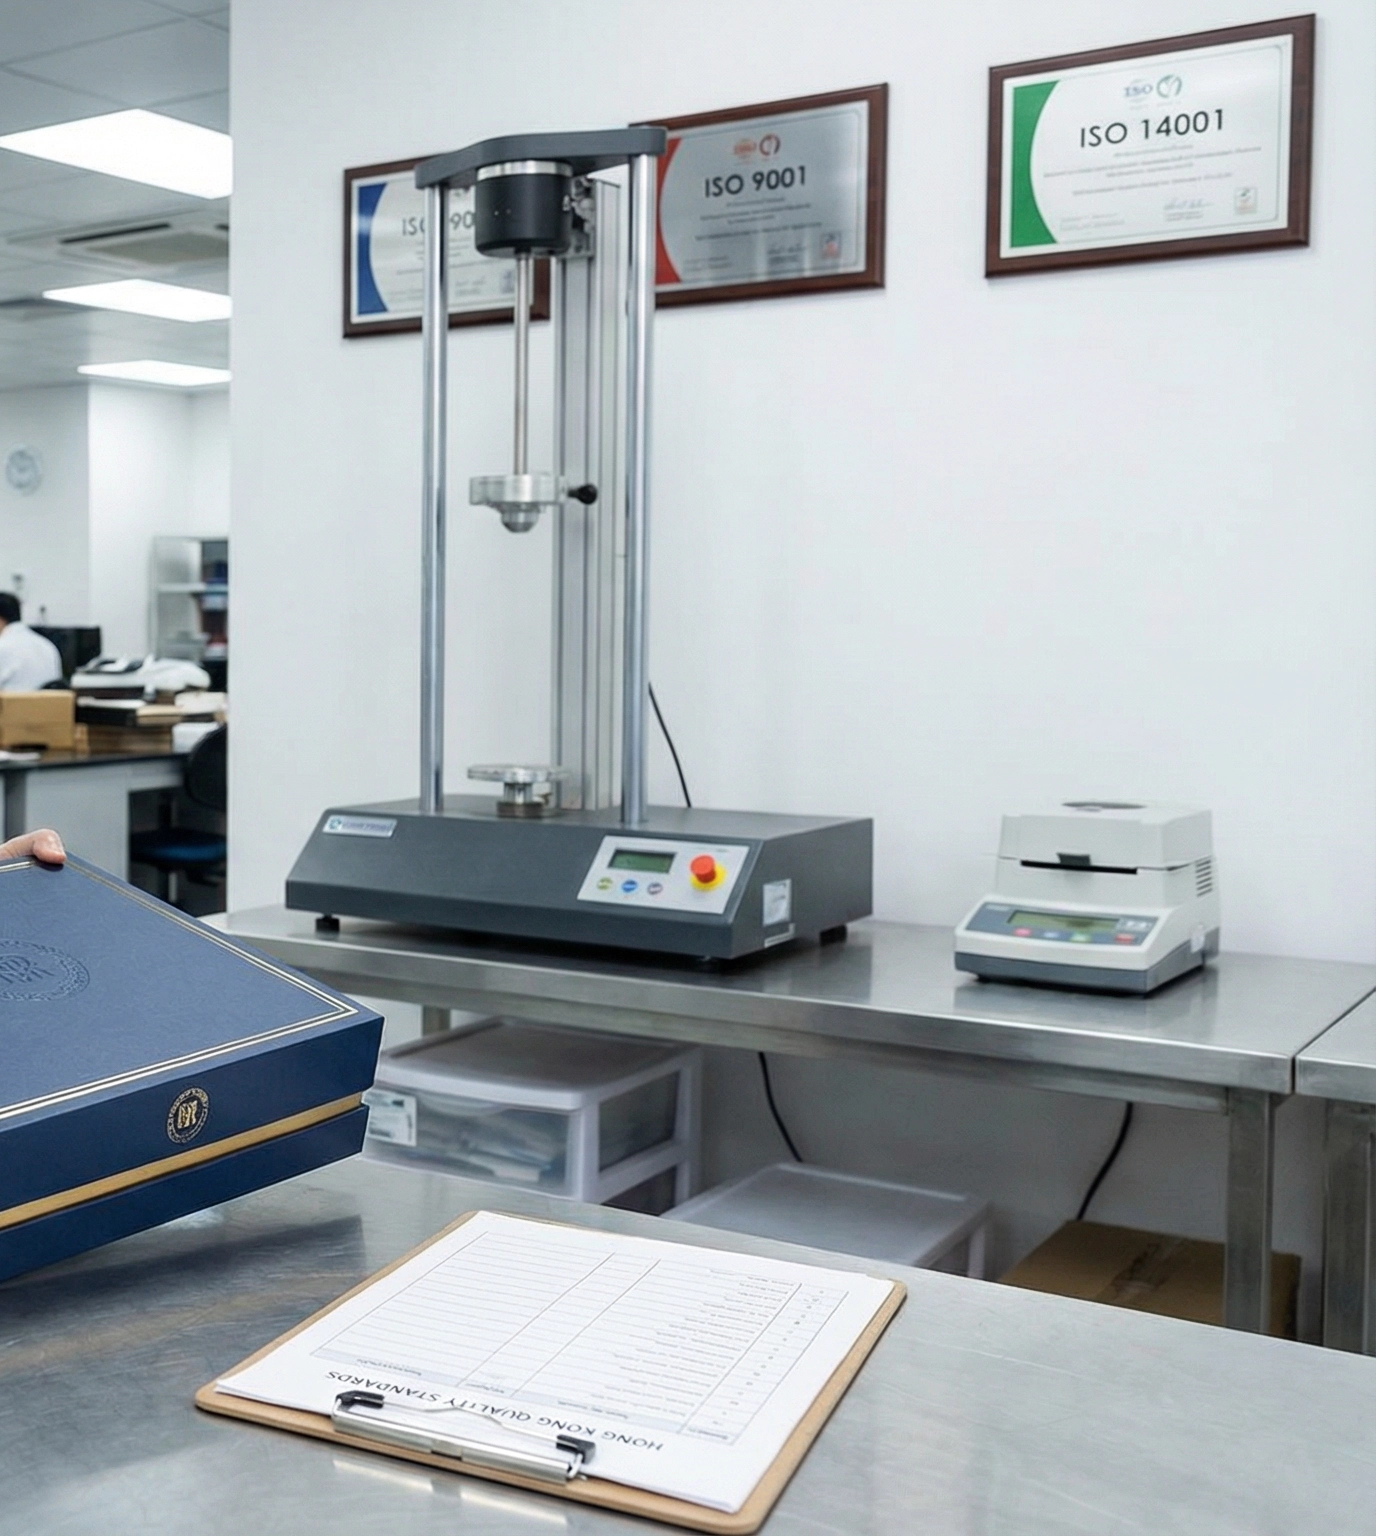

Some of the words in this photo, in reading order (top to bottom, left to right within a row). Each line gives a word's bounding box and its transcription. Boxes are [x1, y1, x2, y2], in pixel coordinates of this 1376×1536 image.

[1080, 122, 1128, 148] ISO
[1141, 109, 1223, 139] 14001
[705, 174, 744, 198] ISO
[752, 165, 806, 191] 9001
[450, 210, 476, 230] 90
[326, 1371, 441, 1401] STANDARDS
[443, 1397, 532, 1422] QUALITY
[537, 1416, 596, 1436] KONG
[601, 1430, 664, 1452] HONG
